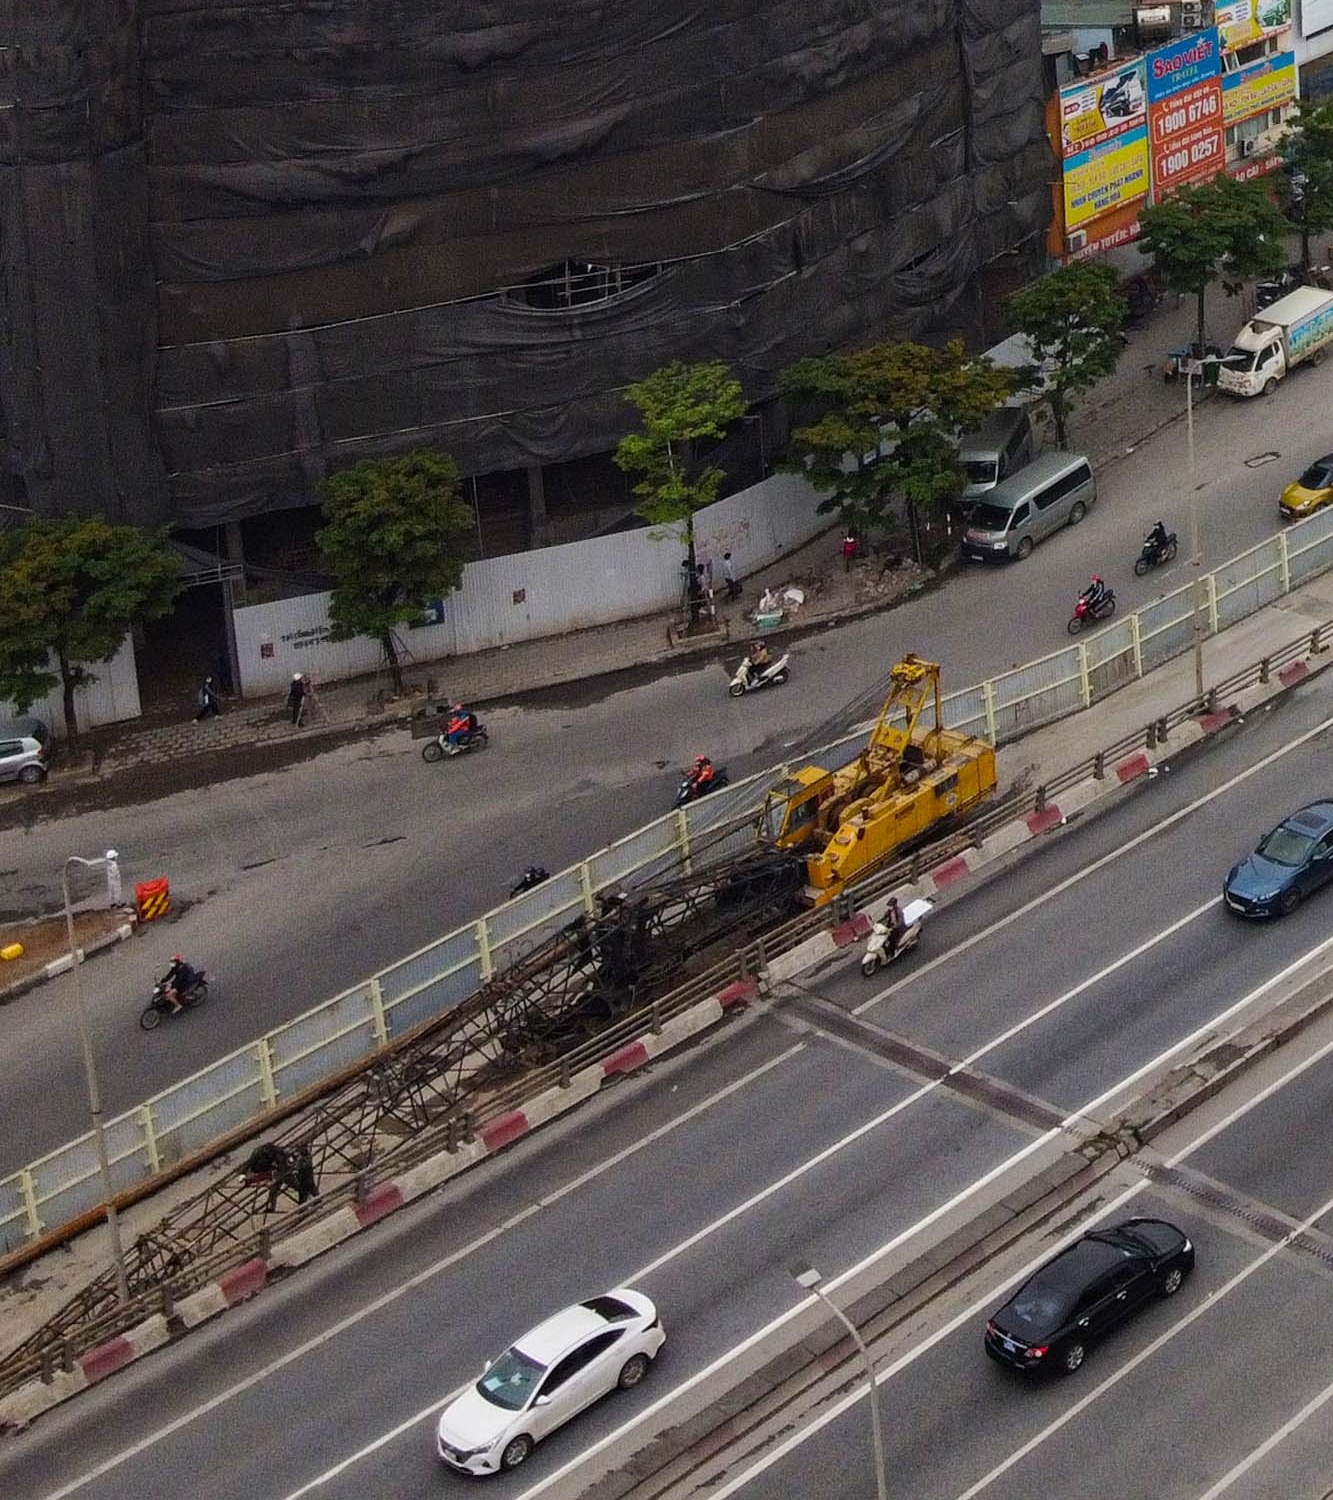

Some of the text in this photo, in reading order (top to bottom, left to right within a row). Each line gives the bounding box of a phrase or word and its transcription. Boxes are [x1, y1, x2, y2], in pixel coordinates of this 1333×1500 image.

[1152, 53, 1183, 80] SAO
[1158, 108, 1187, 137] 1900
[1188, 95, 1217, 123] 6746
[1160, 149, 1189, 178] 1900
[1191, 135, 1220, 164] 0257
